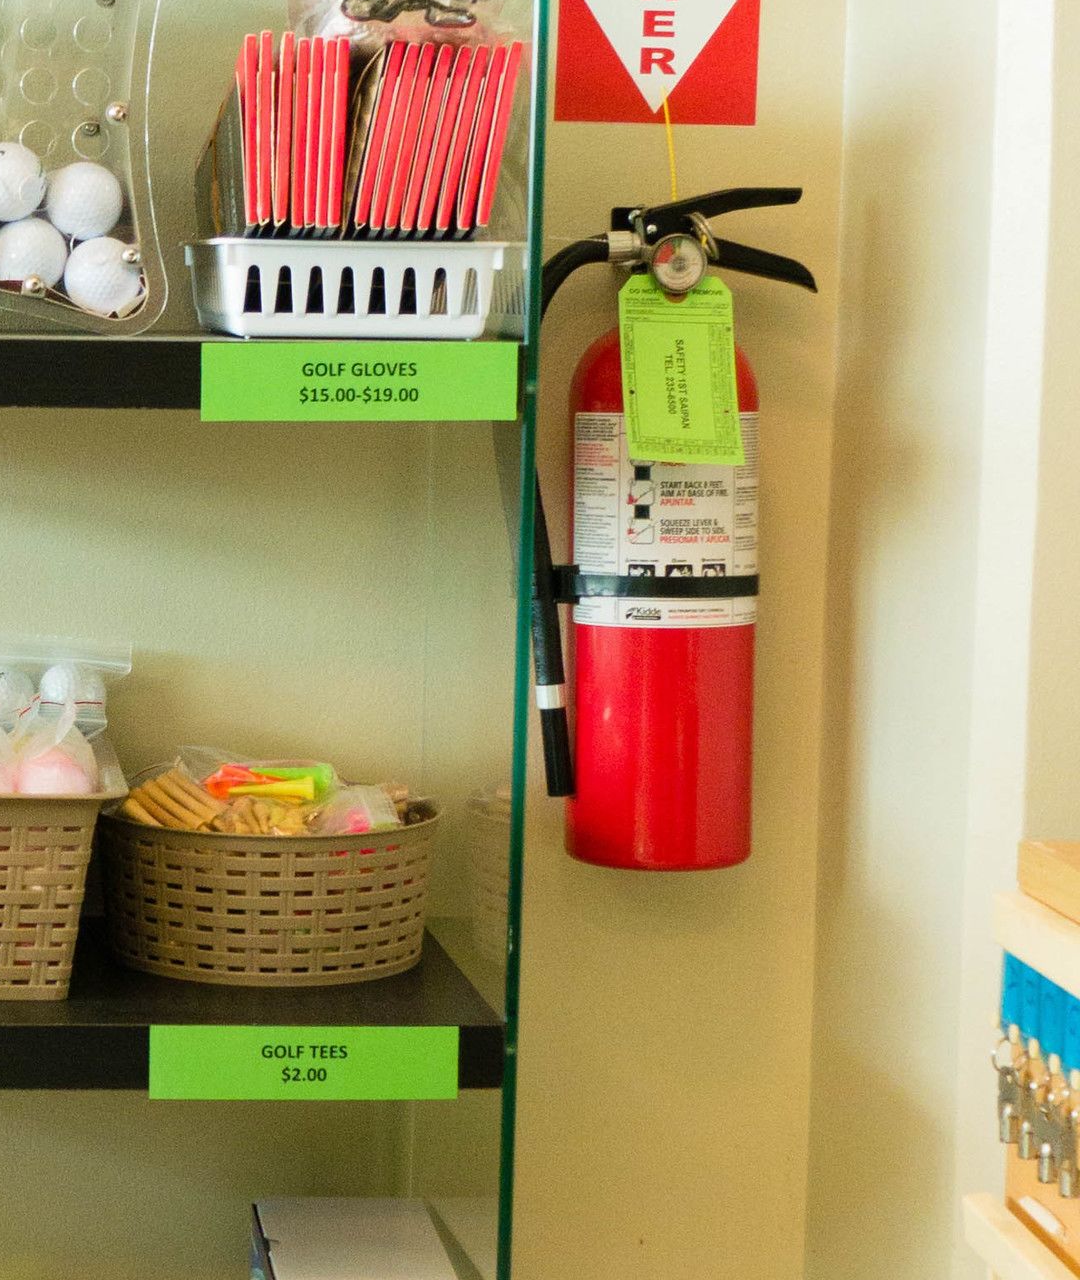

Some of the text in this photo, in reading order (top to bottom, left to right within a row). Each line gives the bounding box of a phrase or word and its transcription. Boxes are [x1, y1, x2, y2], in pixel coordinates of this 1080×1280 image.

[301, 362, 418, 378] GOLF GLOVES
[664, 353, 674, 375] TEL.
[675, 338, 691, 430] SAFETY 1ST SAIPAN
[299, 386, 420, 405] $15.00-$19.00
[660, 480, 682, 489] START
[684, 480, 703, 489] BACK
[676, 489, 686, 497] AT
[687, 488, 705, 497] BASE
[660, 518, 691, 527] SQUEEZE
[635, 607, 661, 616] Kidde
[261, 1044, 348, 1060] GOLF TEES
[281, 1065, 328, 1083] $2.00
